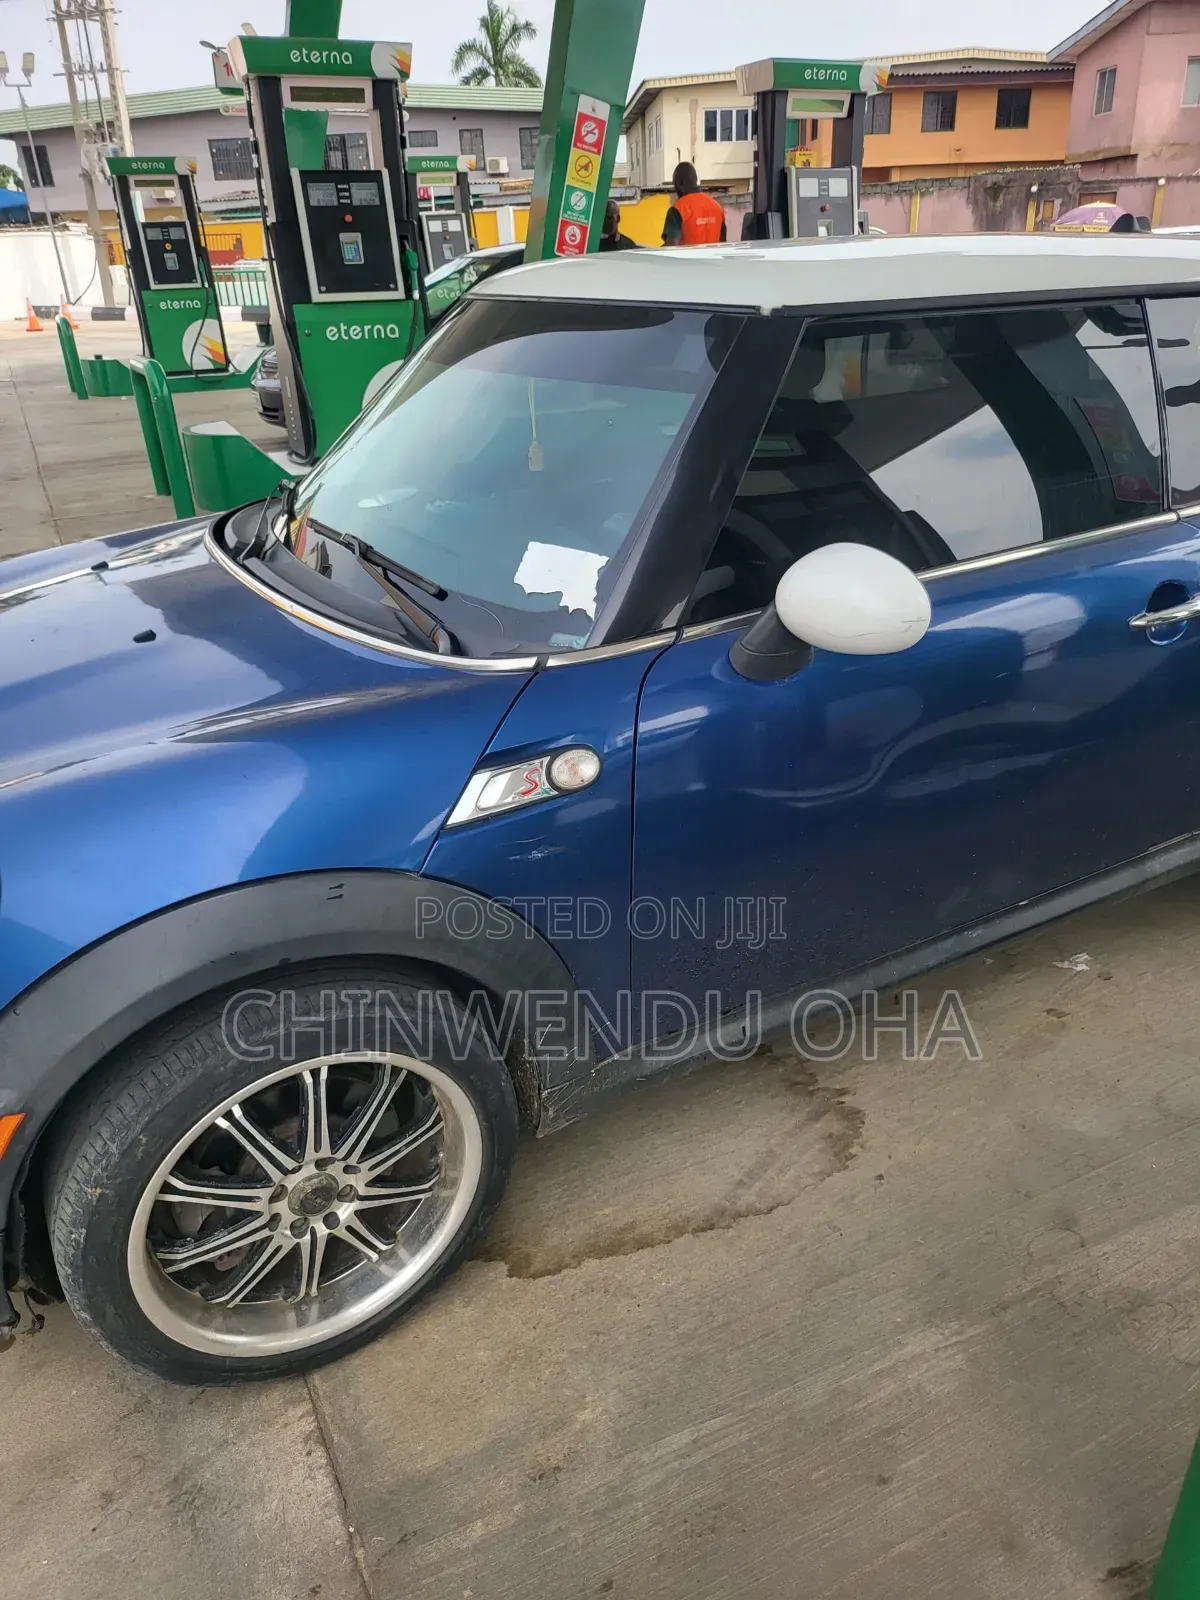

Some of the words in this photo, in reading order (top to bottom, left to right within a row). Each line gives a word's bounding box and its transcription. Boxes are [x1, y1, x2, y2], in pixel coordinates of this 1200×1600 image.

[290, 47, 353, 65] eterna
[804, 66, 847, 81] eterna
[131, 161, 166, 170] eterna
[421, 160, 450, 169] eterna
[159, 299, 202, 310] eterna
[325, 322, 400, 341] eterna
[520, 767, 540, 797] S
